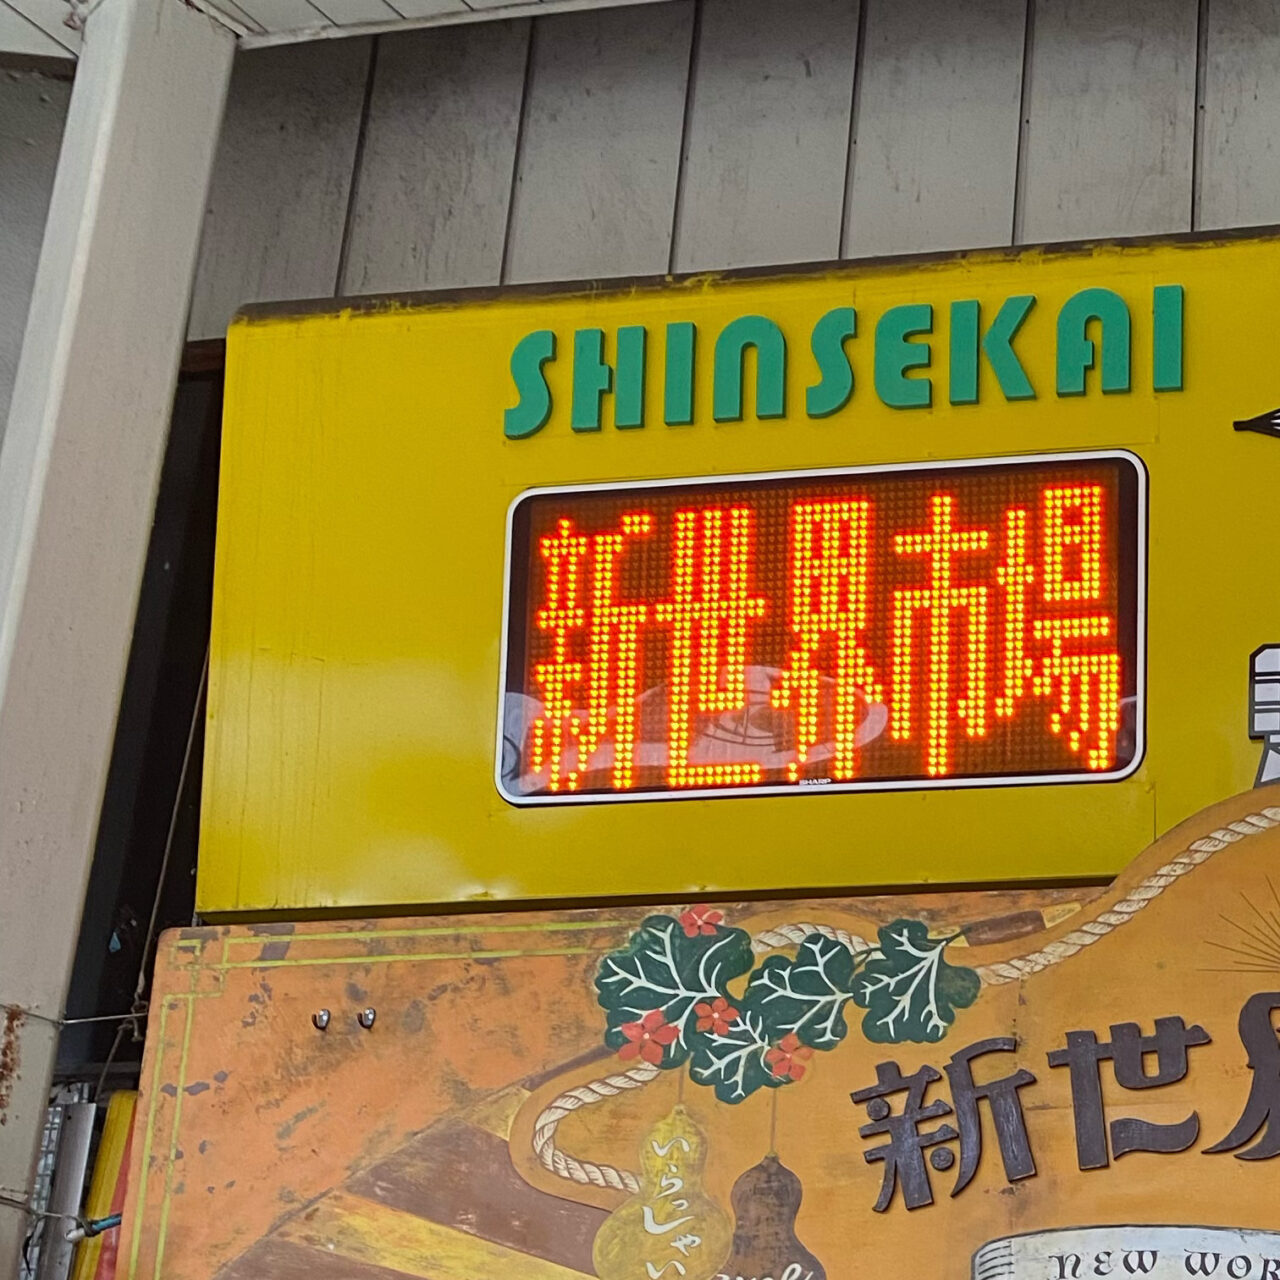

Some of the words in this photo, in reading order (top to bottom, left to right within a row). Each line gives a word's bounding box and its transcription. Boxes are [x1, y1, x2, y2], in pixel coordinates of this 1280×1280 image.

[503, 284, 1184, 440] SHINSEKAI
[528, 484, 1122, 792] 新世界市場
[1049, 1249, 1159, 1280] NEW
